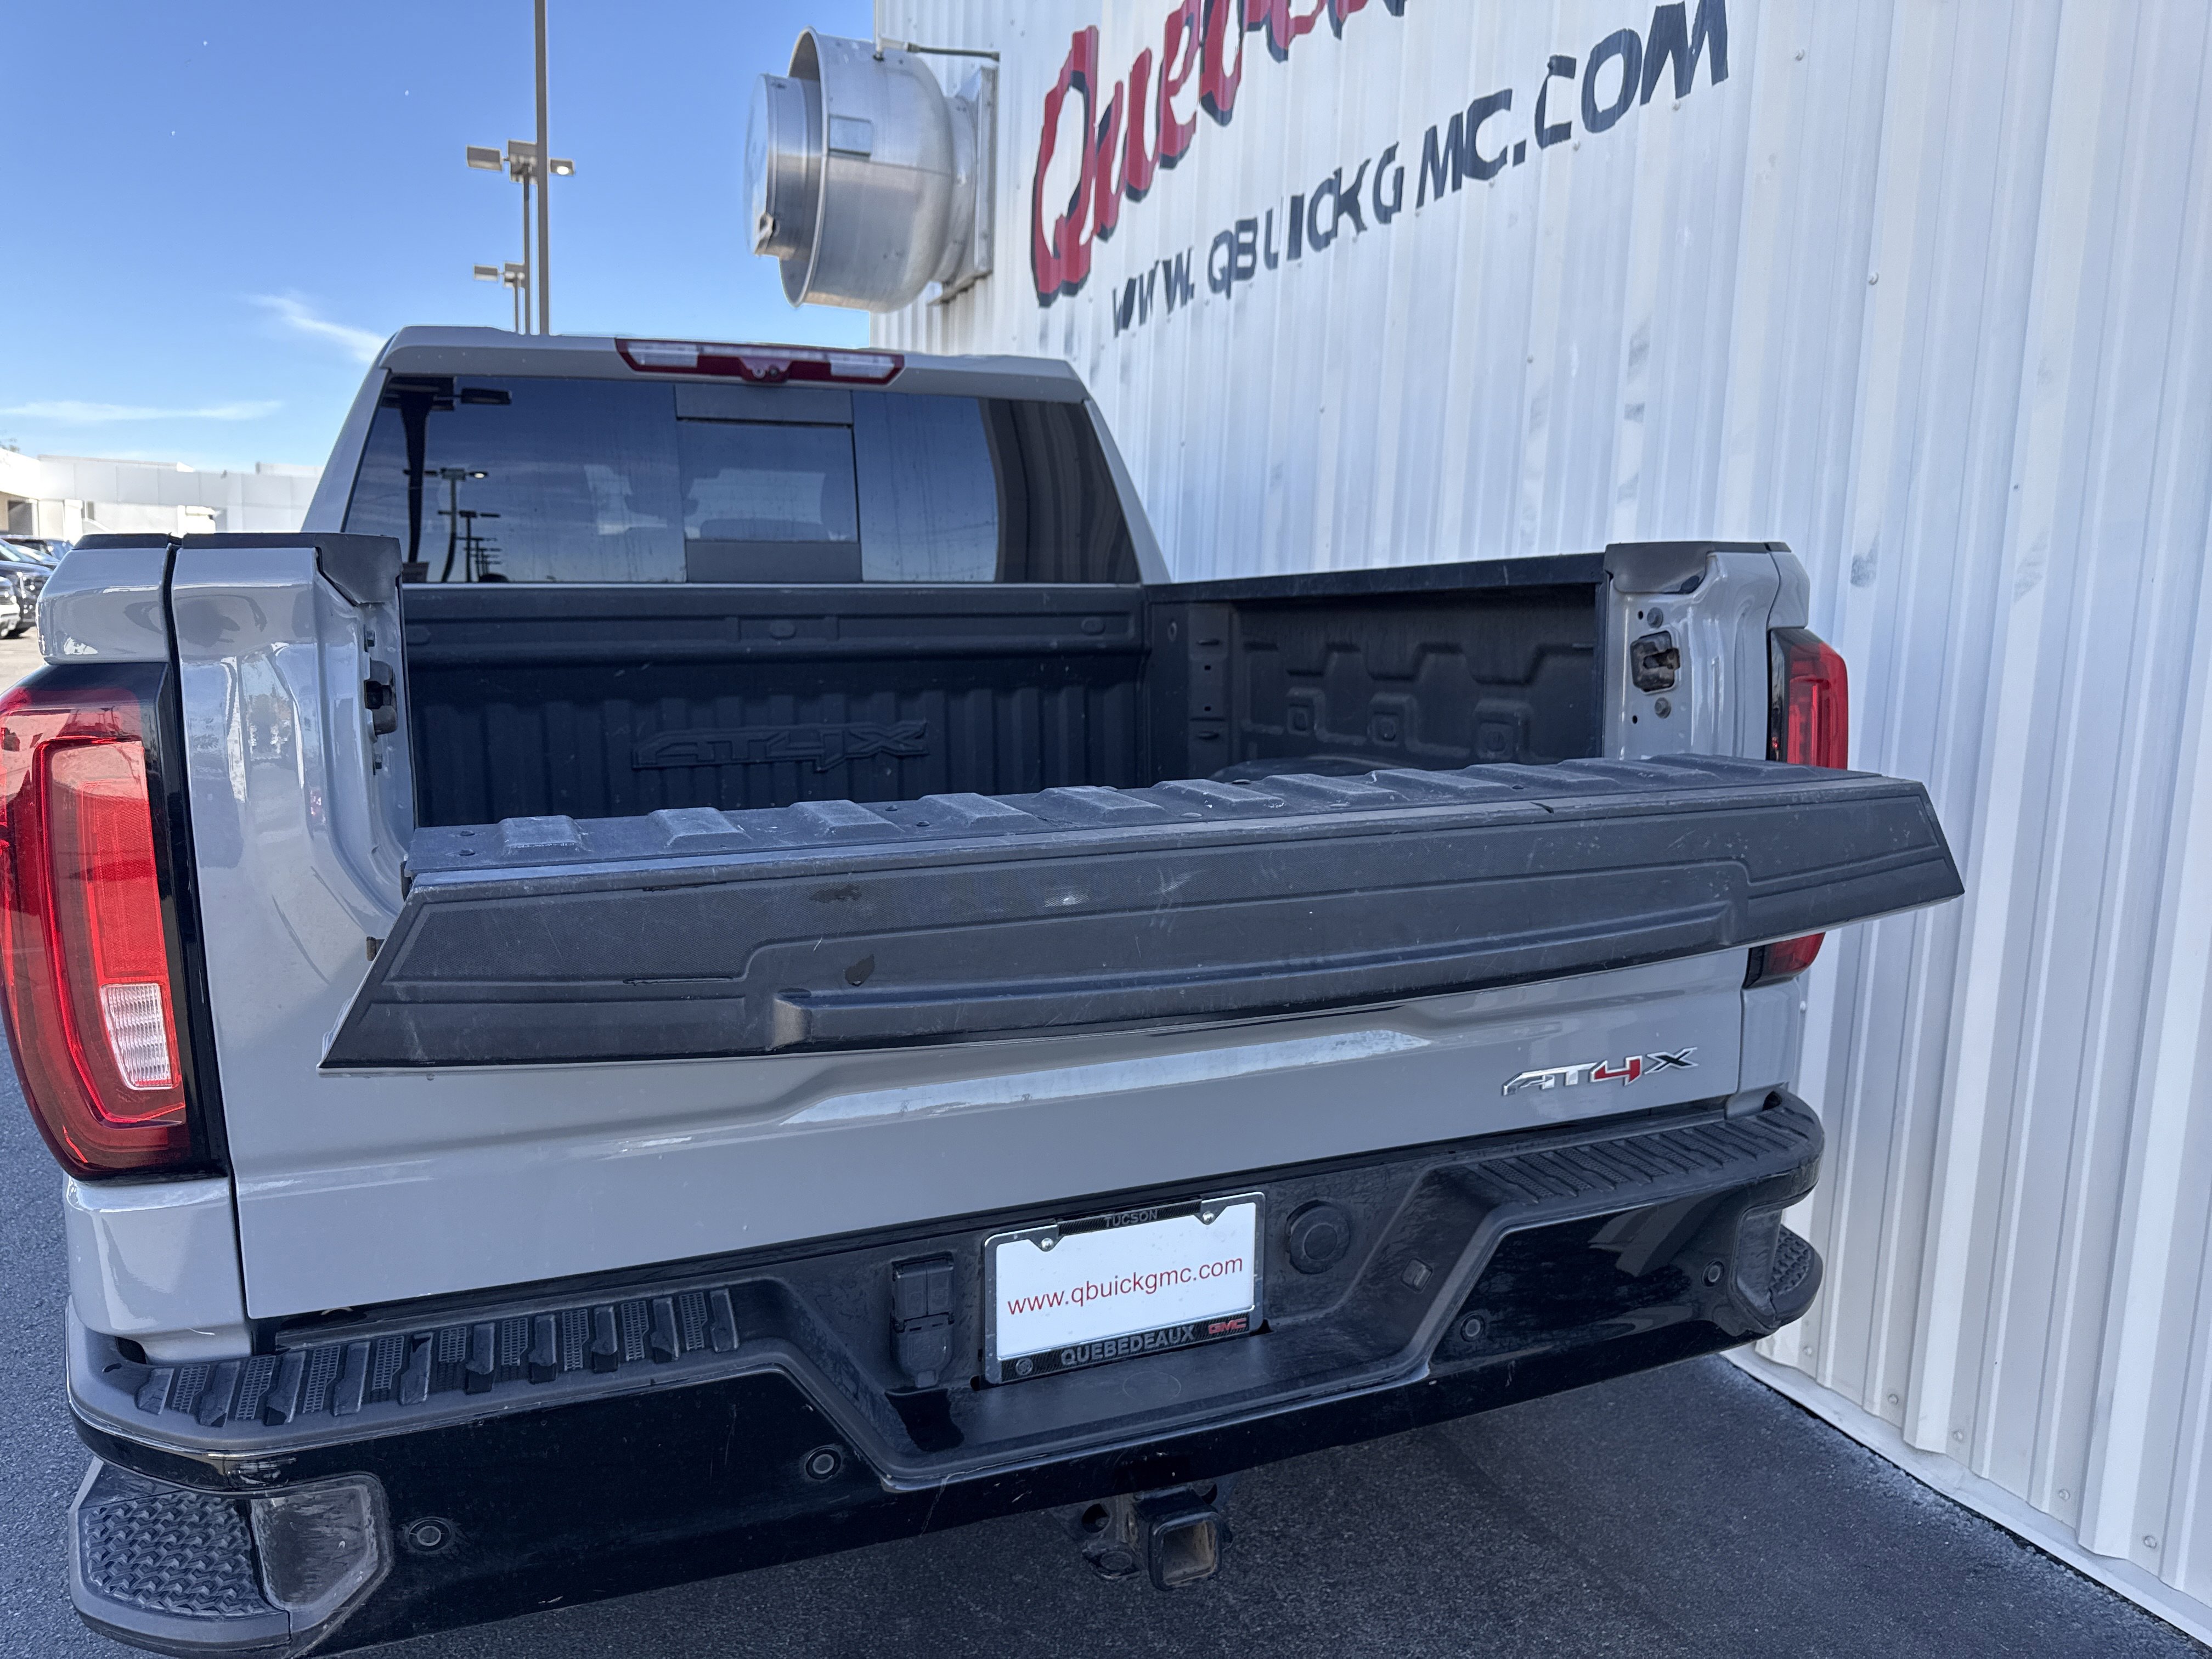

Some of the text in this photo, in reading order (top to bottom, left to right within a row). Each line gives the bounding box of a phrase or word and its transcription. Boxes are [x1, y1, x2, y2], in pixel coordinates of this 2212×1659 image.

[1502, 1047, 1699, 1097] AT4X
[1104, 1208, 1159, 1228] TUCSON
[1007, 1258, 1243, 1316] www.qbuickgmc.com
[1060, 1317, 1248, 1366] QUEBEDEAUX GMC
